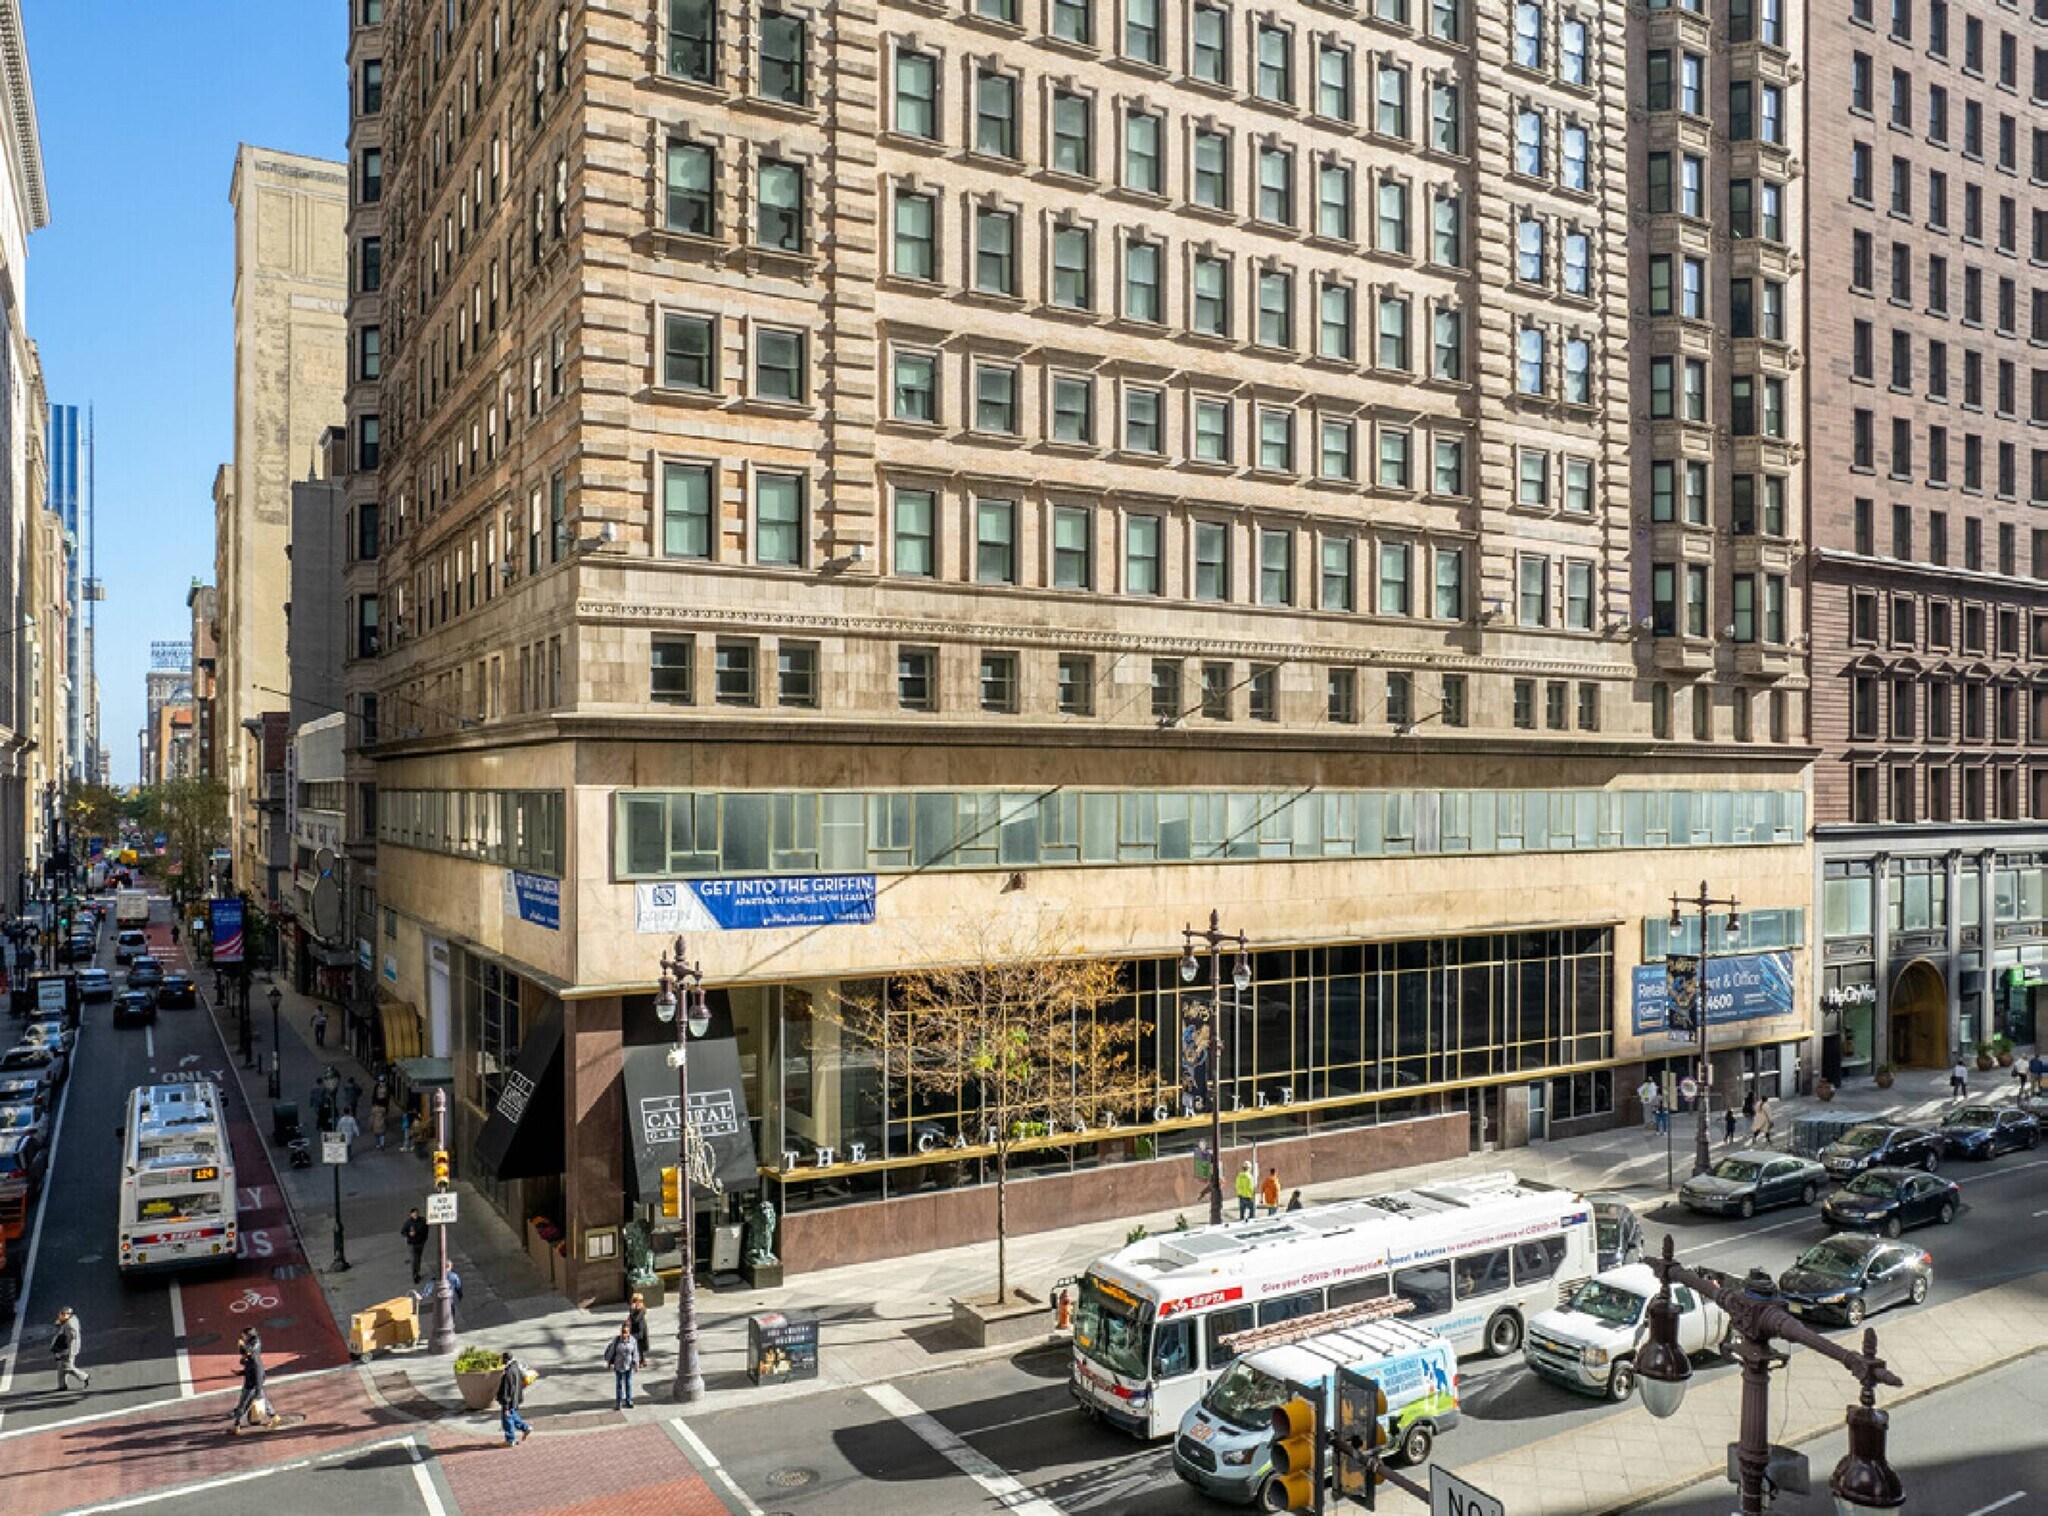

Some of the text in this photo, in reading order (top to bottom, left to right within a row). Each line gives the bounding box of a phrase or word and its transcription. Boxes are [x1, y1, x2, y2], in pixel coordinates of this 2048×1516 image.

[701, 880, 733, 896] GET
[737, 880, 776, 895] INTO
[777, 878, 809, 893] THE
[734, 896, 784, 907] APARTMENT
[162, 1068, 224, 1083] ONLY
[782, 1141, 866, 1172] THE
[1261, 1283, 1281, 1293] Give
[1301, 1267, 1341, 1285] COVID-19
[1191, 1291, 1226, 1308] SEPTA
